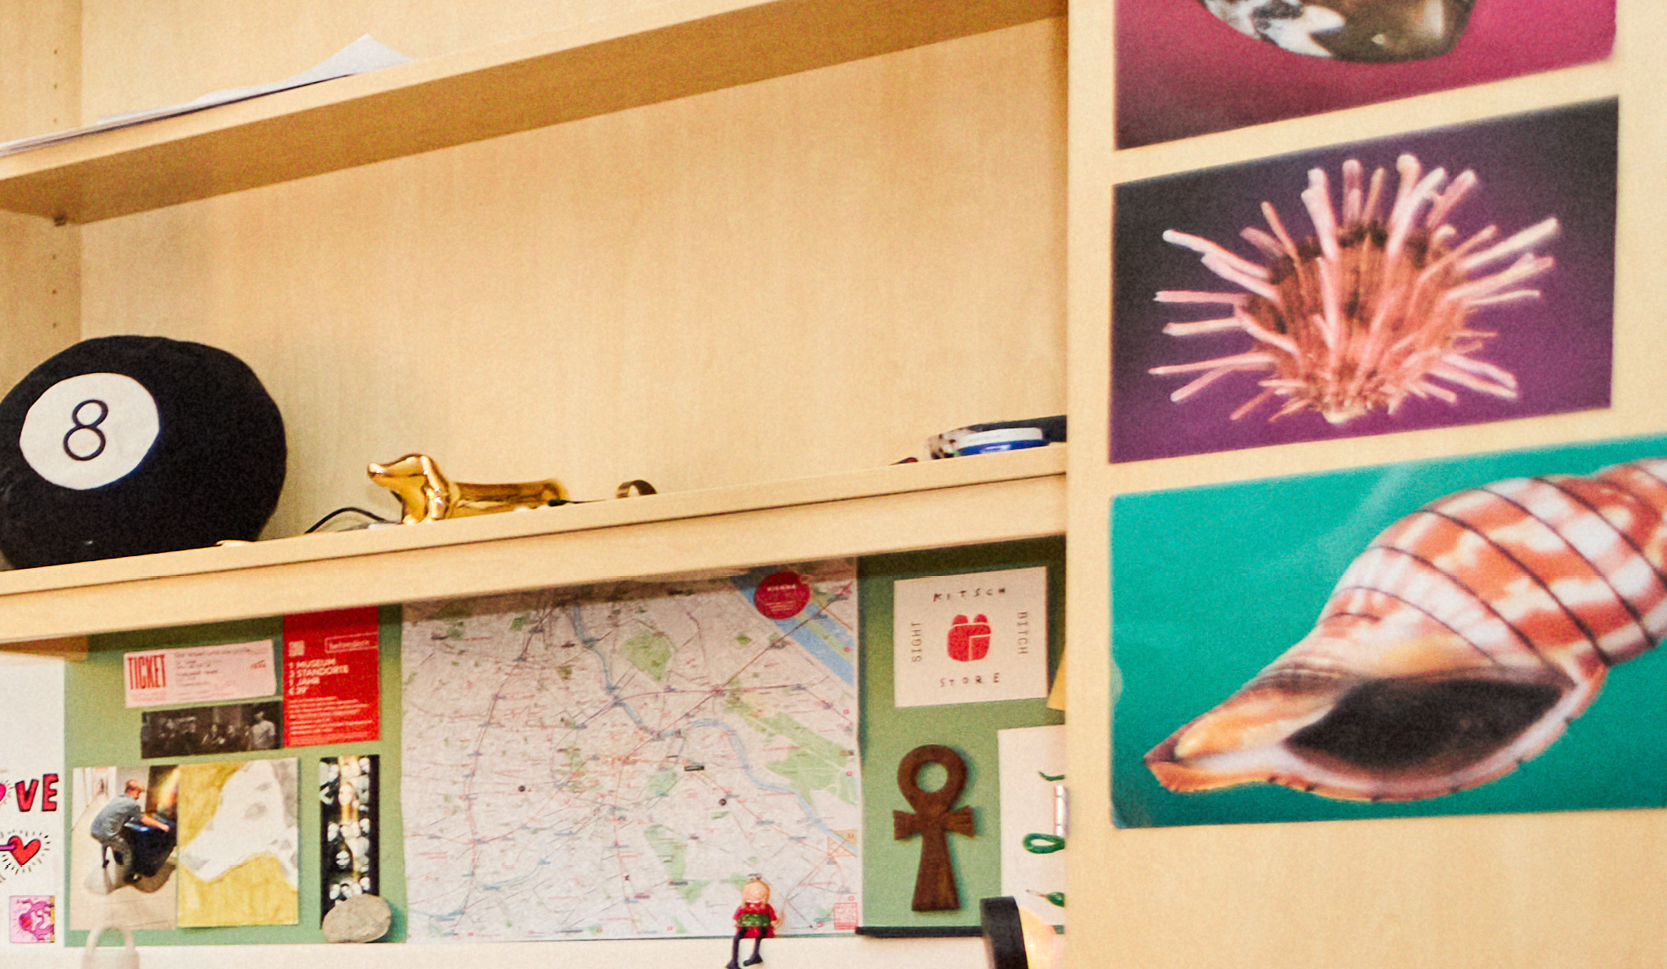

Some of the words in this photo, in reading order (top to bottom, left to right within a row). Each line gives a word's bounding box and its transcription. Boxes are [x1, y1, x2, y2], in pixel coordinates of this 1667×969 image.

[62, 398, 109, 462] 8
[932, 587, 1007, 603] KITSCH
[910, 621, 923, 663] SIGHT
[126, 653, 167, 691] TICKET
[939, 672, 1001, 688] STORE
